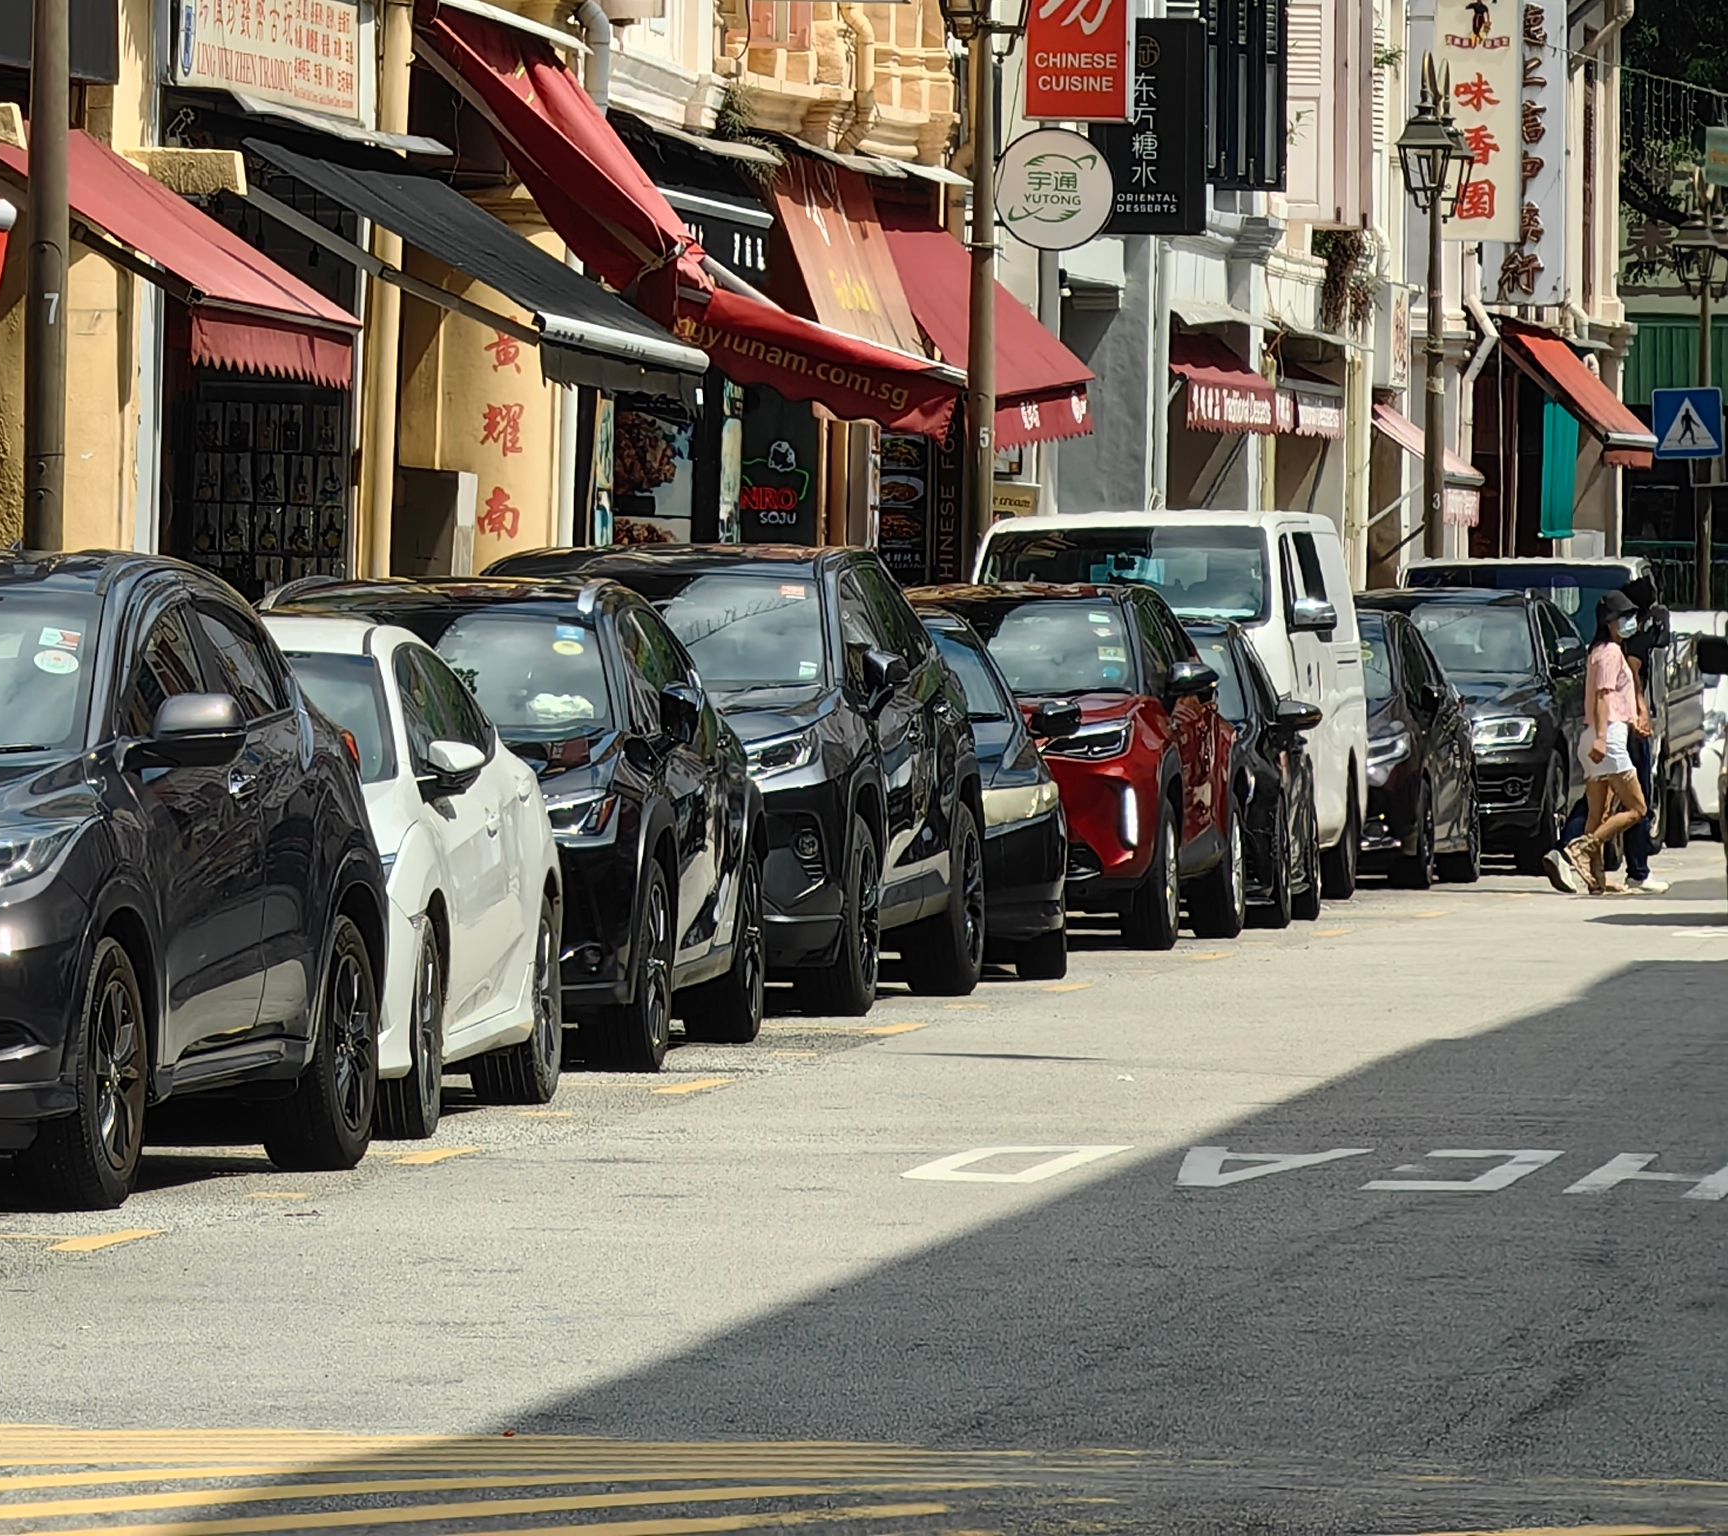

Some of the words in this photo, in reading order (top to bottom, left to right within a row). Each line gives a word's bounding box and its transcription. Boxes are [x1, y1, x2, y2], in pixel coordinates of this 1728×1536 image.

[197, 42, 216, 78] LING
[218, 45, 234, 80] WEI
[235, 49, 257, 85] ZHEN
[259, 55, 293, 93] TRADING
[1034, 52, 1118, 70] CHINESE
[1038, 74, 1114, 93] CUISINE
[1027, 171, 1078, 193] 宇通
[1024, 194, 1081, 206] YUTONG
[1117, 193, 1178, 203] ORIENTAL
[1117, 204, 1177, 213] DESSERTS
[44, 292, 59, 325] 7
[980, 427, 989, 448] 5
[741, 487, 798, 510] NRO
[1433, 493, 1441, 510] 3
[759, 511, 796, 524] SOJU
[939, 485, 955, 578] HINESE
